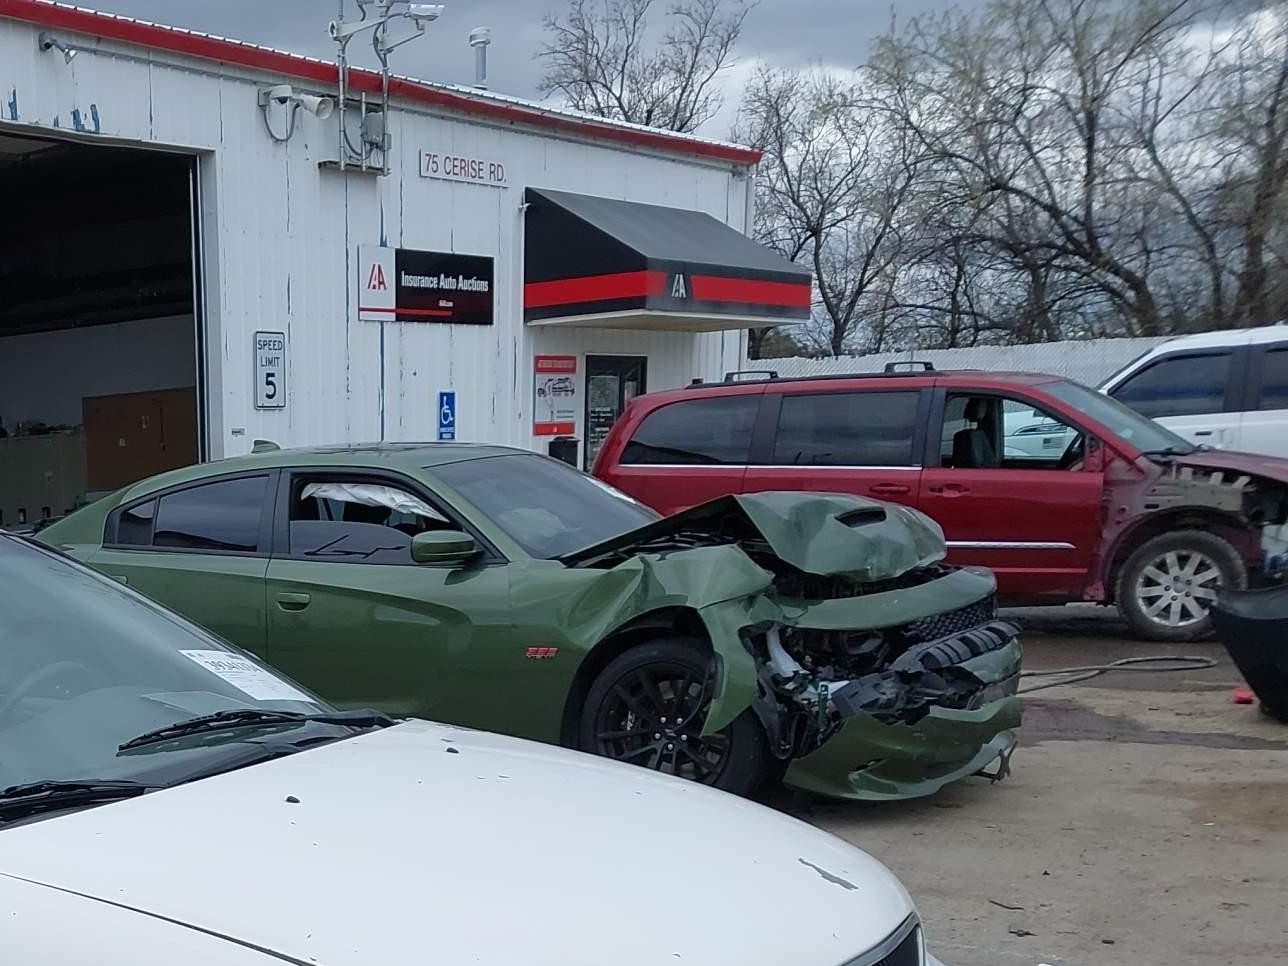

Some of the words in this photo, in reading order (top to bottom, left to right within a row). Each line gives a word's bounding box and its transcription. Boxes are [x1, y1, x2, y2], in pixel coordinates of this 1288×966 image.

[425, 153, 439, 174] 75
[443, 156, 485, 180] CERISE
[489, 162, 508, 183] RD.
[400, 269, 439, 289] Insurance
[439, 272, 457, 290] Auto
[457, 274, 490, 292] Auctions
[257, 339, 283, 351] SPEED
[260, 356, 281, 368] LIMIT
[265, 372, 277, 400] 5
